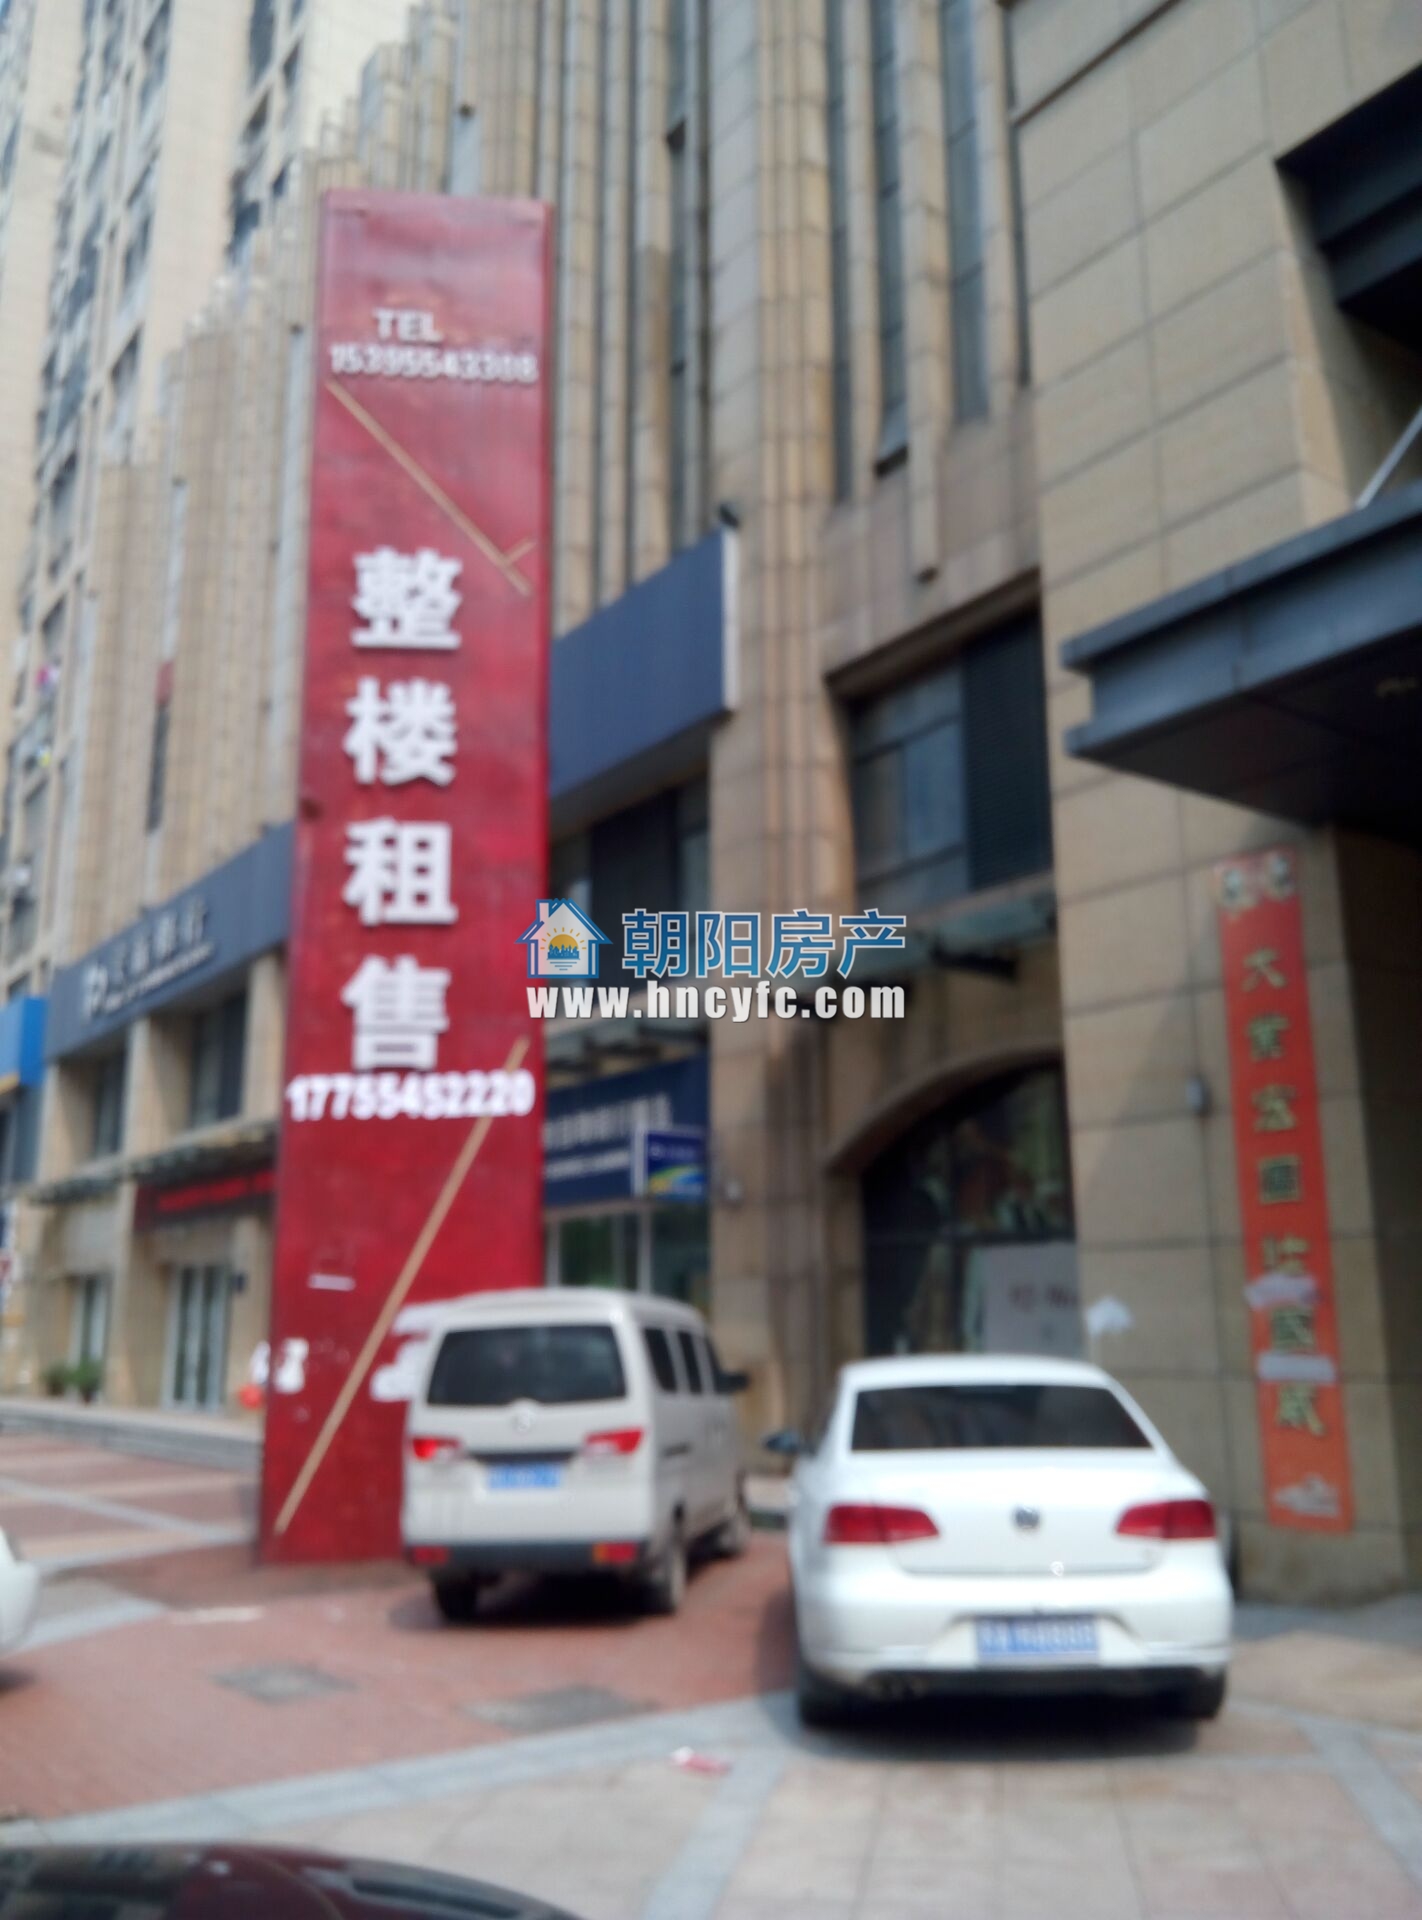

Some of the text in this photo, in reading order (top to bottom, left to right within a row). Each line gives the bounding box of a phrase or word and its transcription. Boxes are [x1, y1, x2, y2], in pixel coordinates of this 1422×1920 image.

[341, 546, 463, 1070] 整楼租售
[286, 1069, 536, 1121] 17755452220
